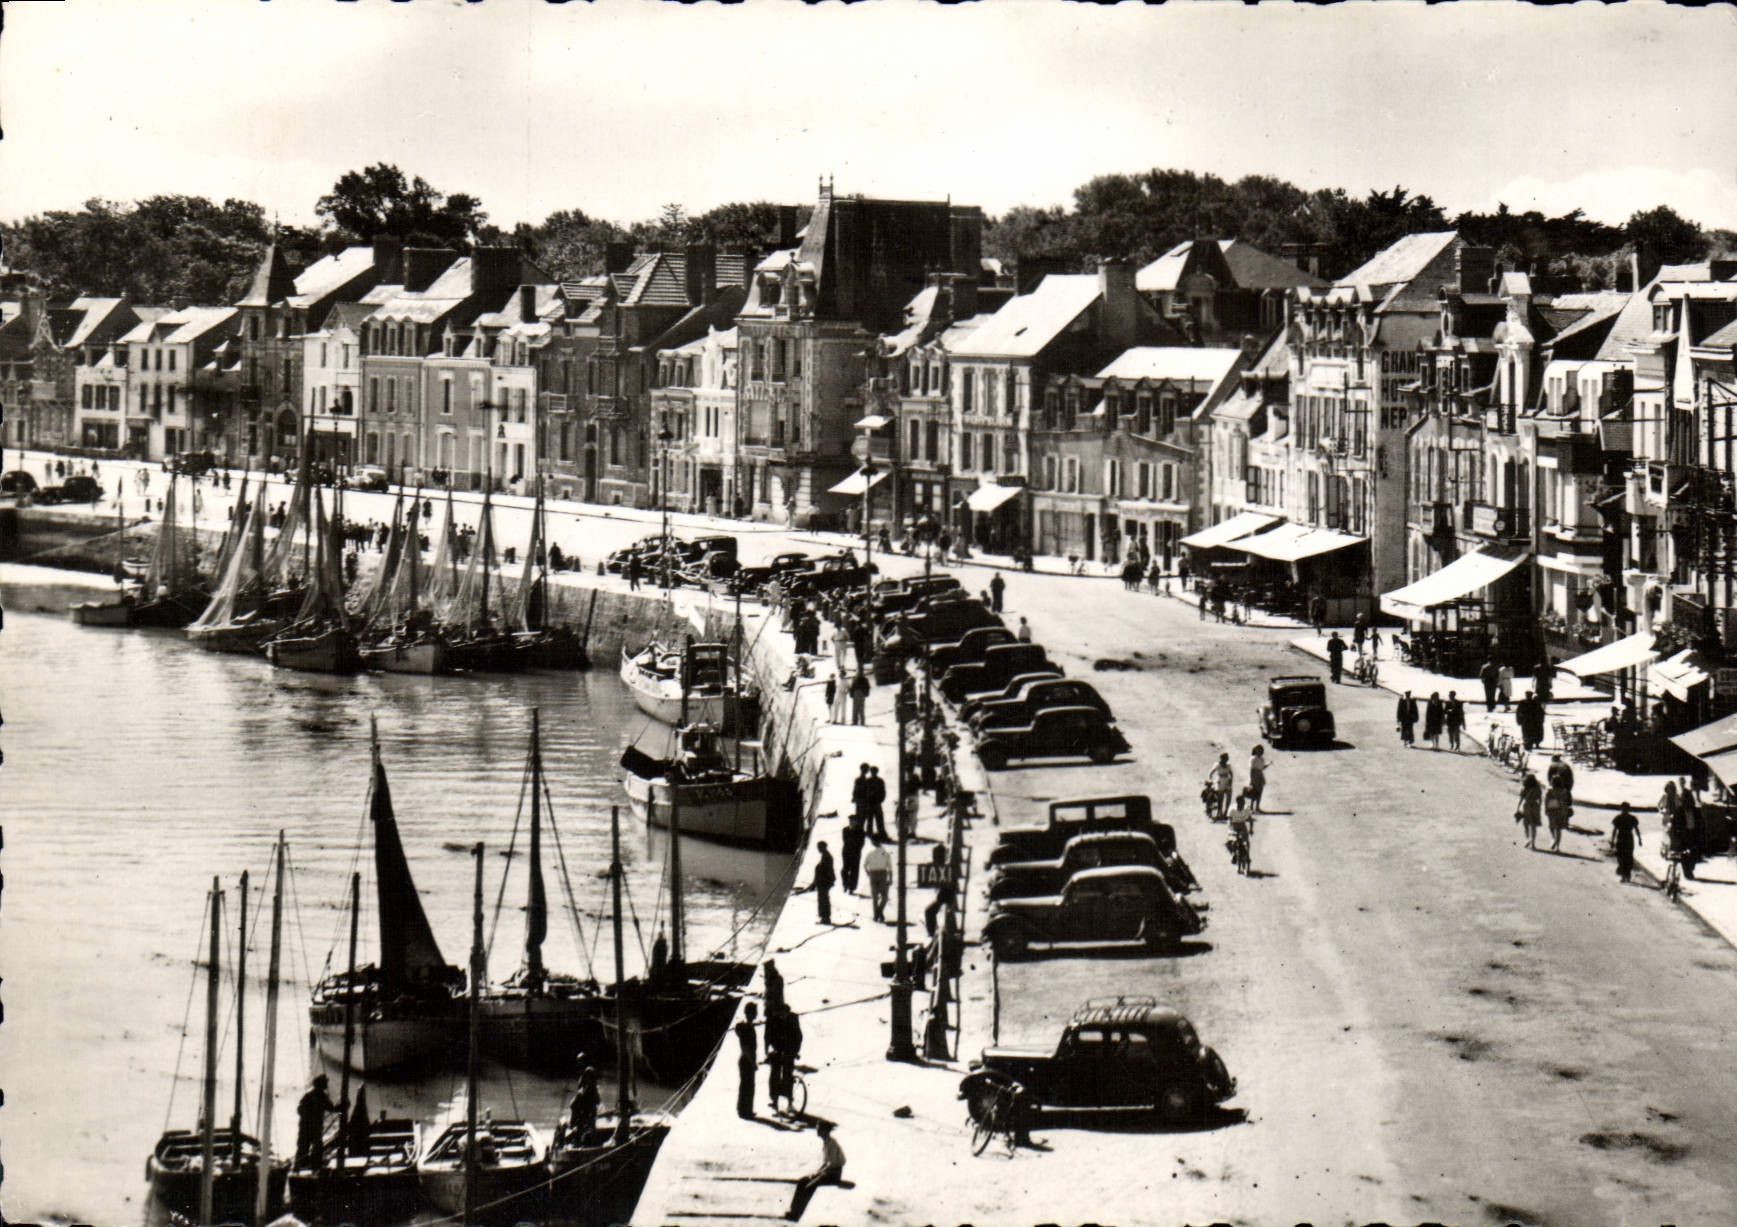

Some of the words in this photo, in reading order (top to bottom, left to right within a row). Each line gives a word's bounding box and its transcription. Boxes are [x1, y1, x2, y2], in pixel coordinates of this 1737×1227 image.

[1382, 350, 1420, 373] GRAN
[1381, 407, 1407, 429] NEP
[920, 866, 952, 884] TAXI
